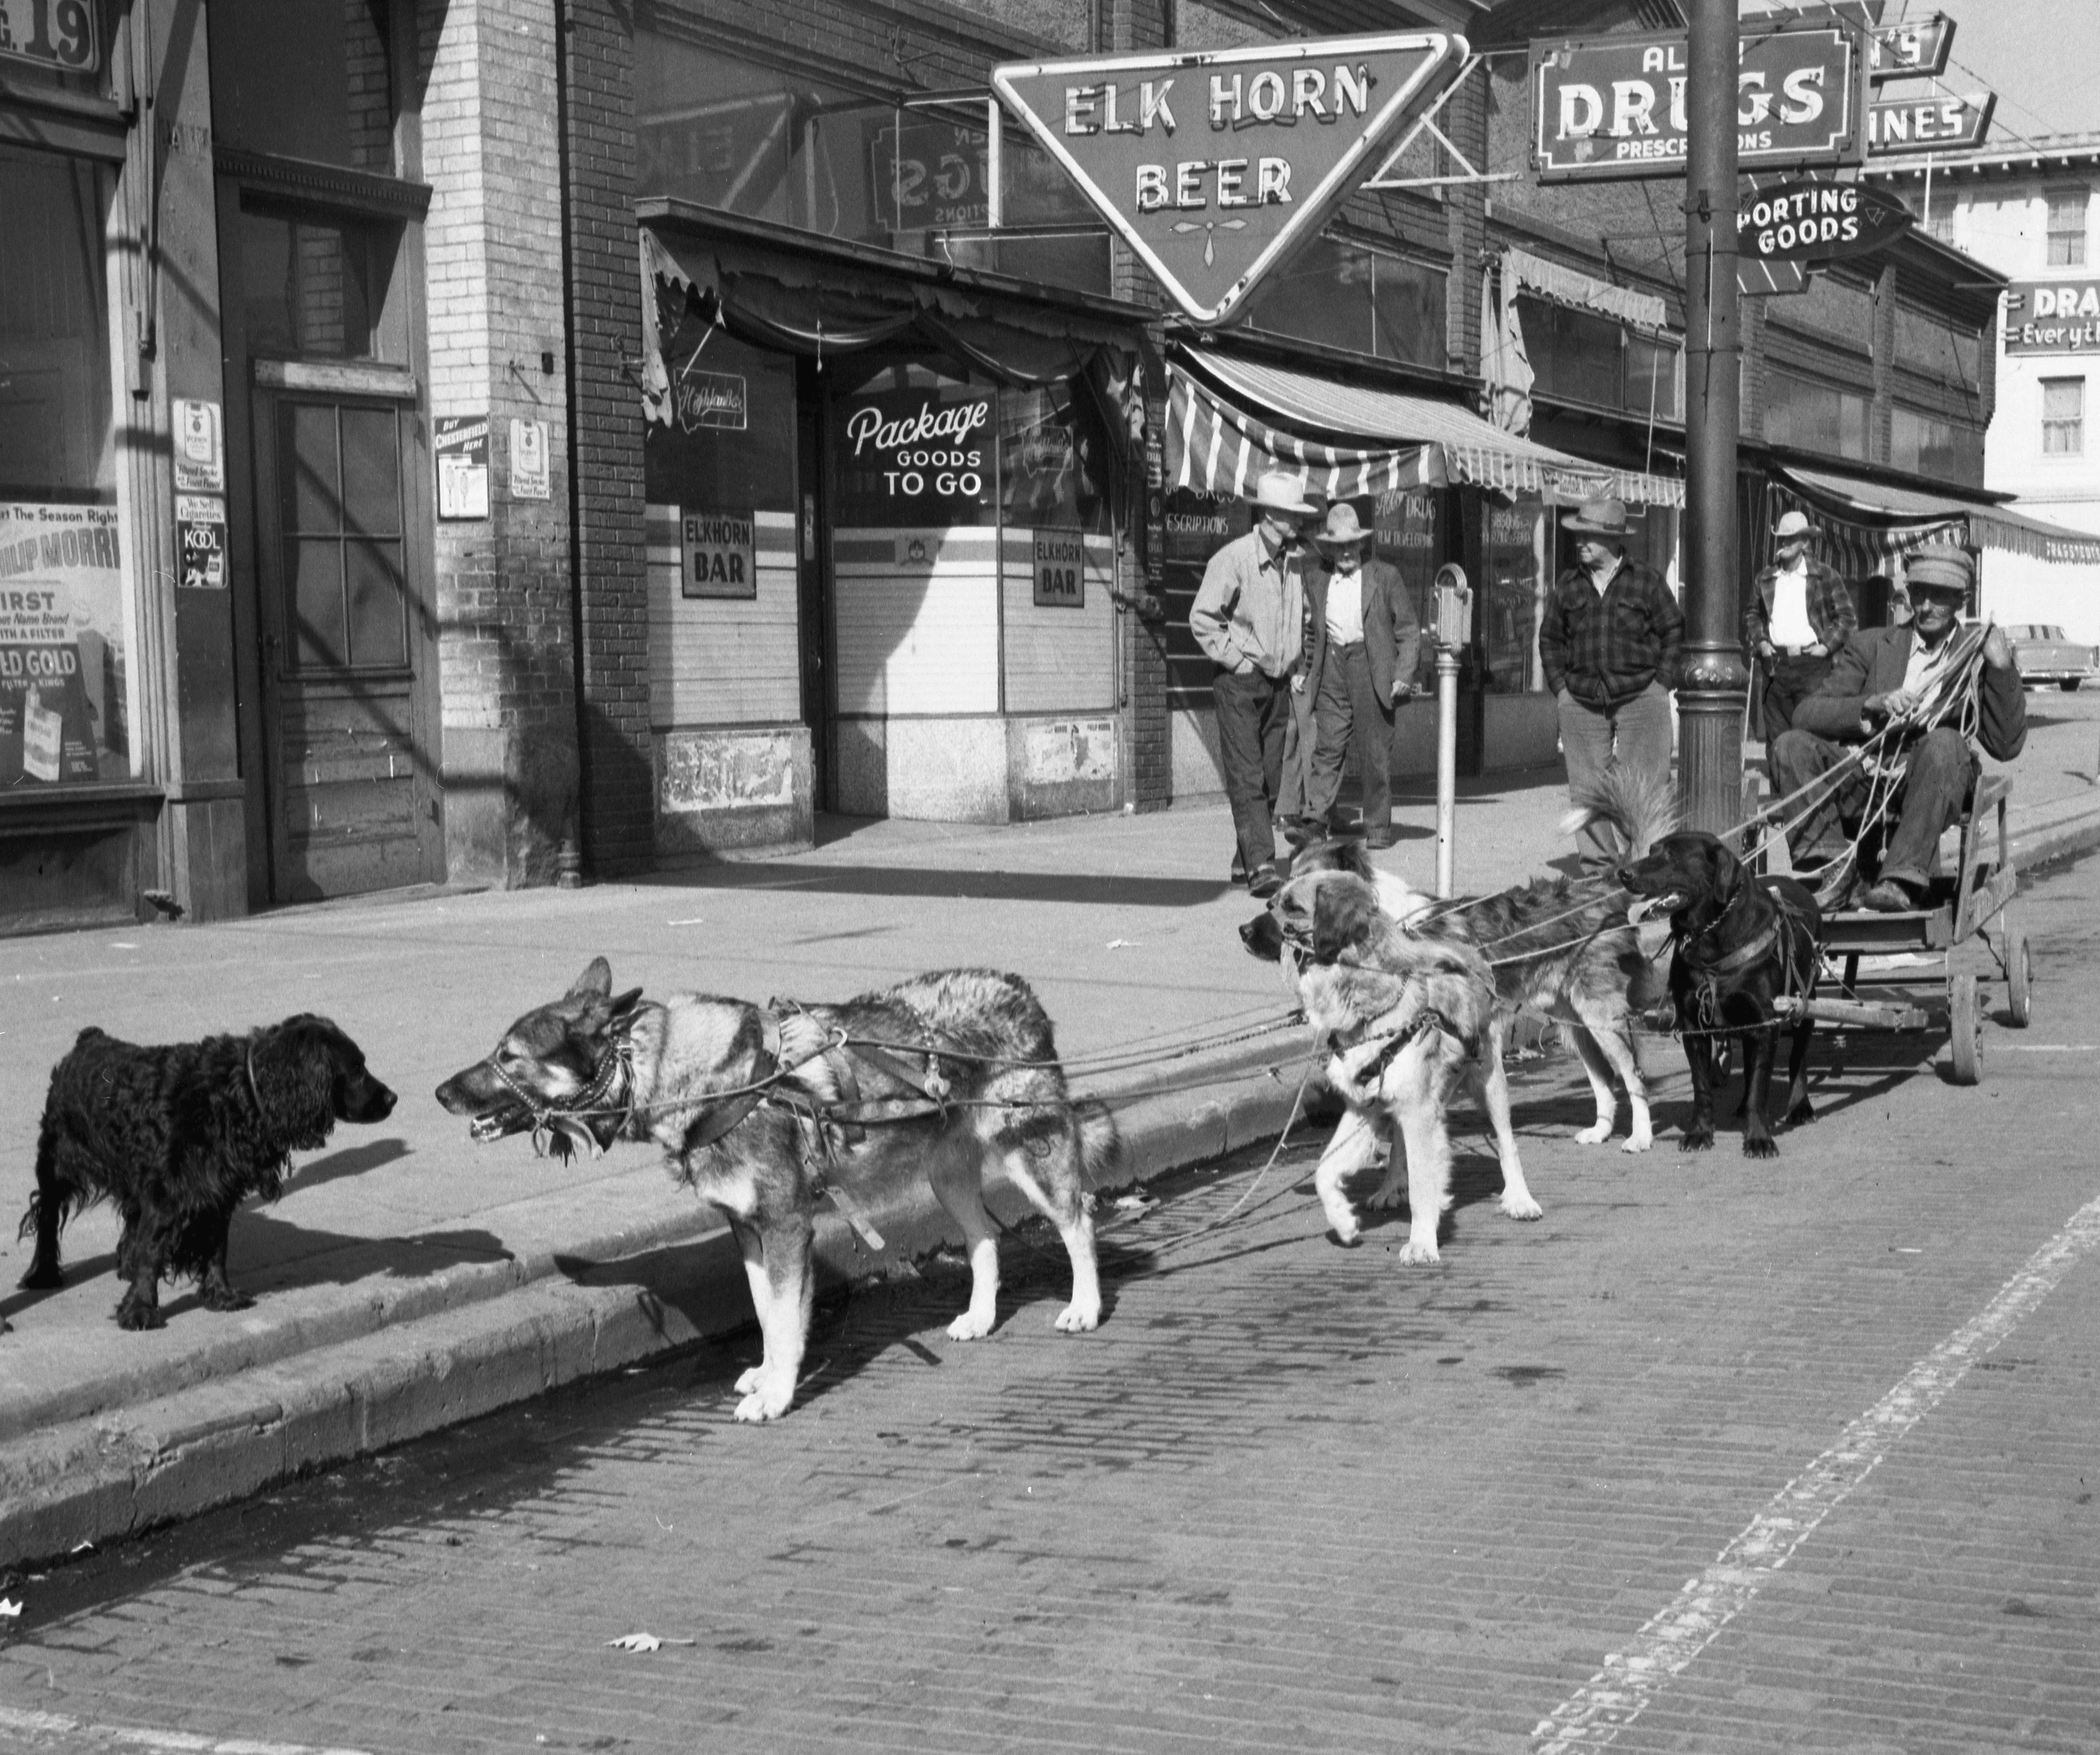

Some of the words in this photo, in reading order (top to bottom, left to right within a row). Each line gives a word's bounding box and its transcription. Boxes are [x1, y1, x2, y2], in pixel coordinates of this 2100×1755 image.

[1065, 79, 1176, 134] ELK
[1209, 64, 1368, 123] HORN
[1136, 157, 1292, 208] BEER
[1758, 216, 1859, 254] GOODS
[2033, 287, 2100, 318] DRA
[443, 418, 459, 431] BUY
[847, 401, 988, 457] Package
[463, 438, 483, 453] HERE
[897, 450, 981, 467] GOODS
[884, 472, 924, 496] TO
[936, 472, 982, 496] GO
[13, 506, 34, 521] The
[38, 507, 83, 522] Season
[1165, 513, 1228, 535] ESCRIPTIONS
[185, 529, 220, 549] KOOL
[686, 519, 750, 545] ELKHORN
[1037, 541, 1081, 562] ELKHORN
[695, 551, 744, 583] BAR
[1042, 568, 1076, 594] BAR
[26, 649, 76, 676] GOLD
